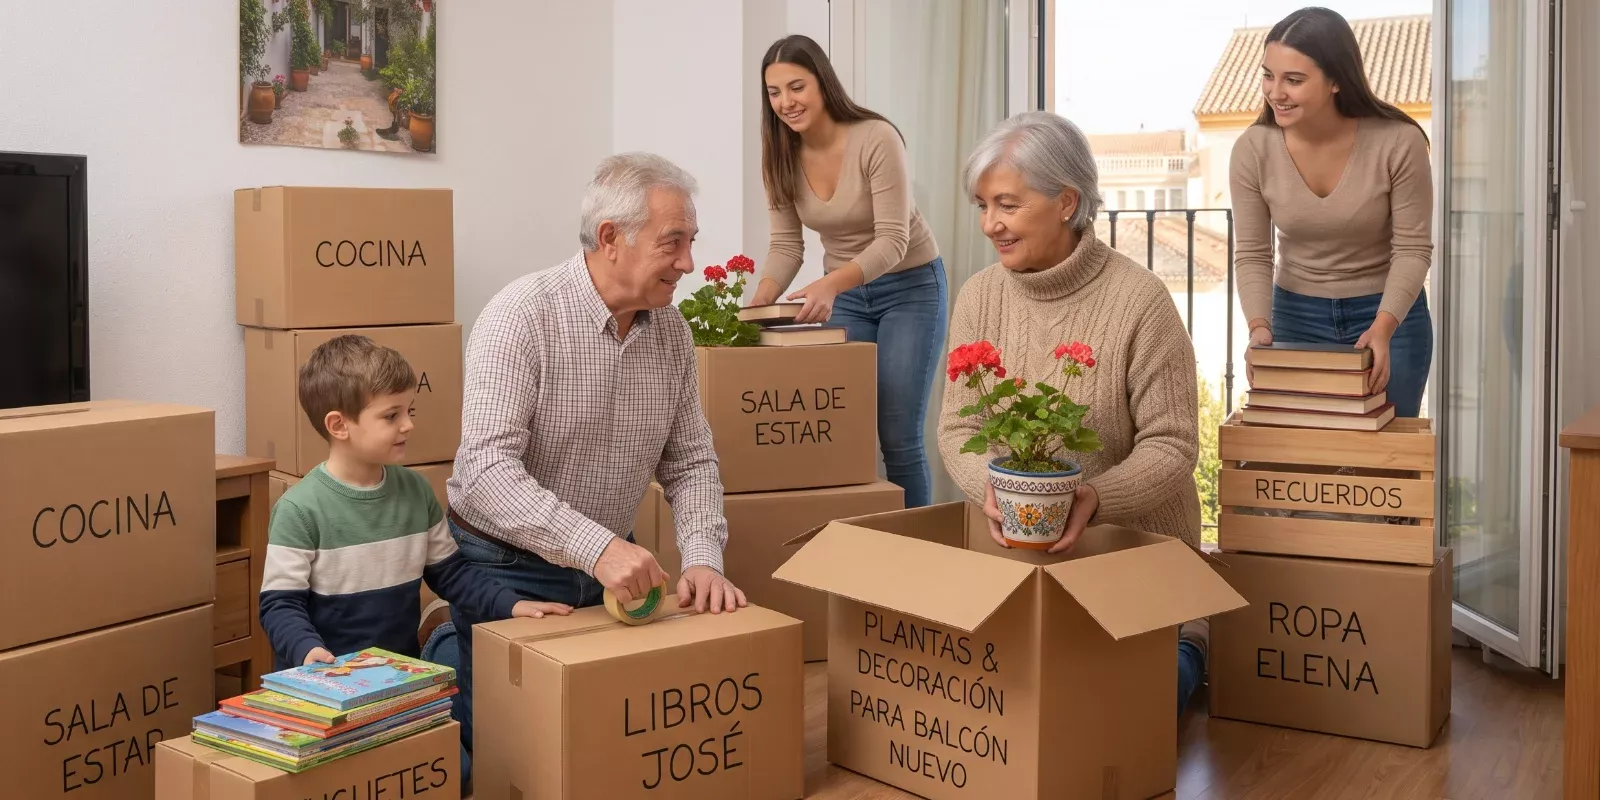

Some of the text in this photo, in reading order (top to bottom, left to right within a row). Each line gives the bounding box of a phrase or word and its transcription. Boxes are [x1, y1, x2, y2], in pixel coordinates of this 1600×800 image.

[315, 239, 427, 268] COCINA
[741, 386, 846, 413] SALA DE
[754, 419, 833, 446] ESTAR
[32, 490, 177, 549] COCINA
[1255, 478, 1403, 509] RECUERDOS
[865, 610, 999, 673] PLANTAS &
[1269, 601, 1367, 646] ROPA
[858, 648, 1004, 717] DECORACIÓN
[1257, 647, 1379, 695] ELENA
[43, 676, 179, 746] SALA DE
[624, 672, 763, 738] LIBROS
[851, 689, 1008, 766] PARA BALCÓN
[641, 720, 744, 790] JOSÉ
[890, 739, 967, 788] NUEVO
